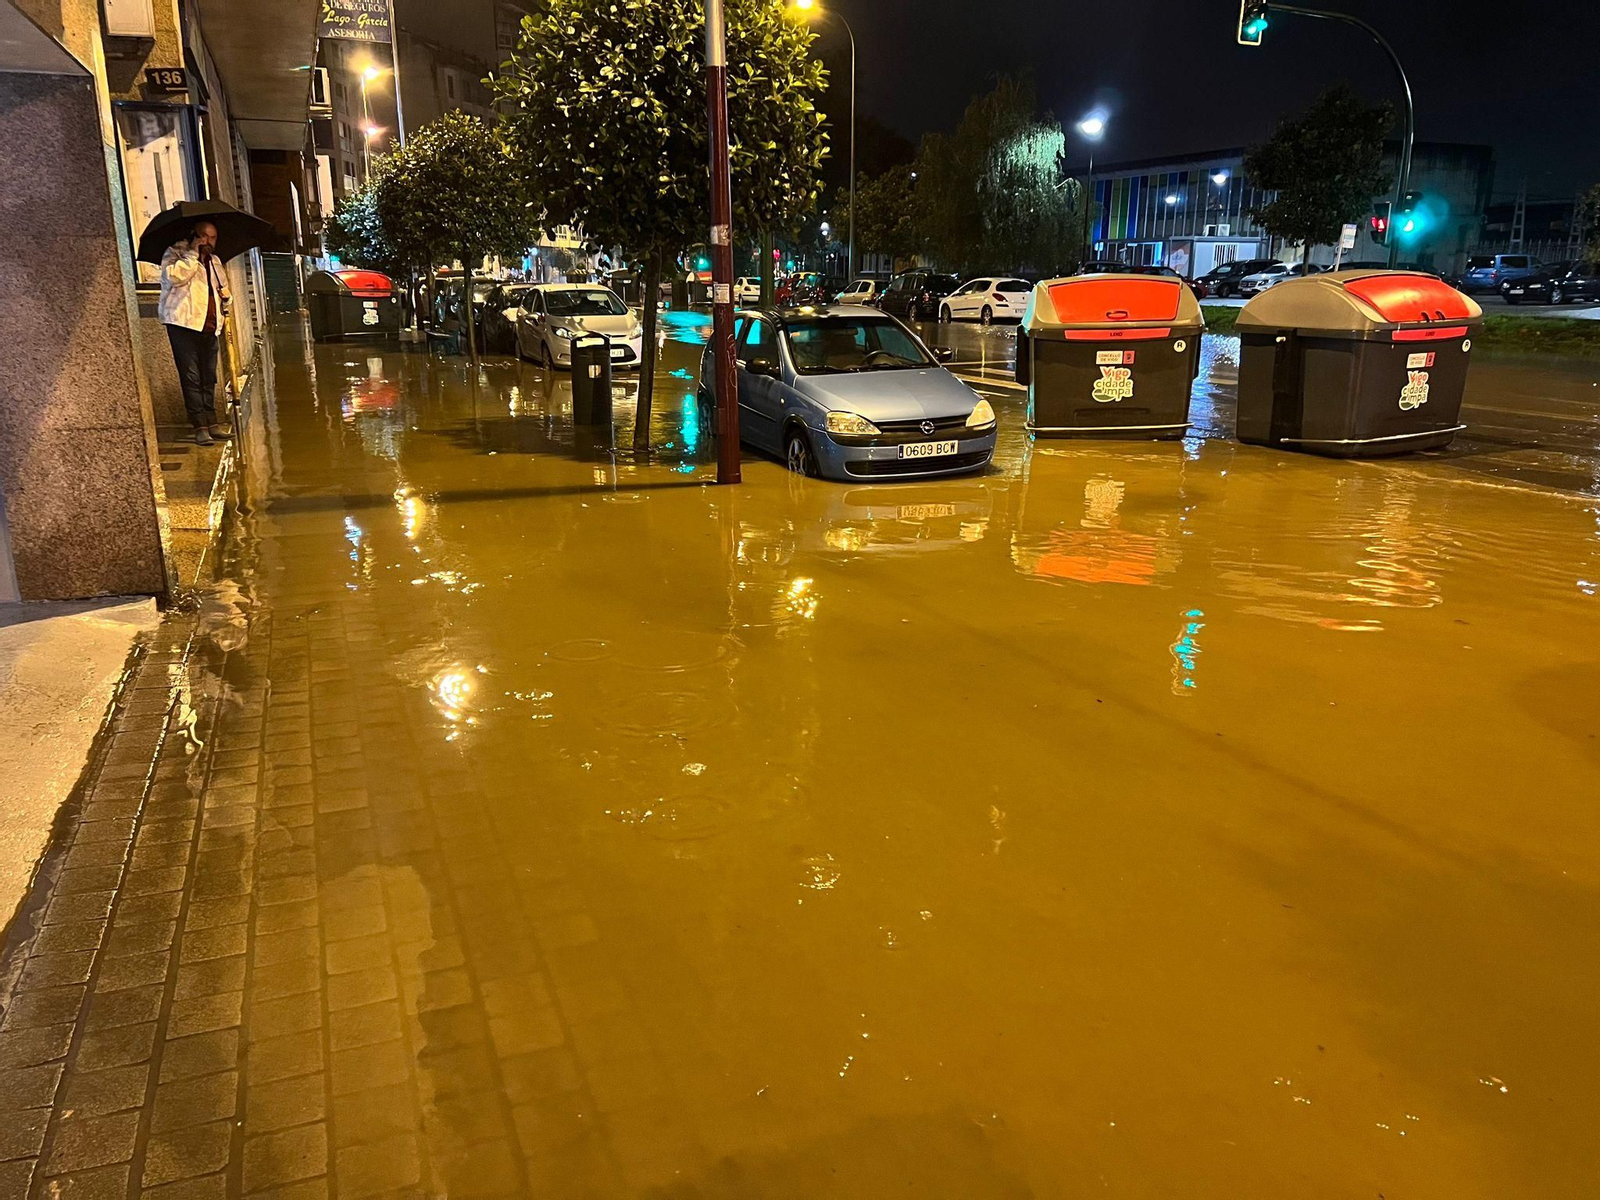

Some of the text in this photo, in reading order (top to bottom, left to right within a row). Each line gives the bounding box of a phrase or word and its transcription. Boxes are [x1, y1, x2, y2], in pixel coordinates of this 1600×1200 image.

[343, 2, 386, 13] SEGUROS
[323, 10, 351, 26] Lago
[328, 28, 376, 40] ASESORIA
[151, 71, 182, 85] 136
[1102, 368, 1129, 381] Vigo
[1095, 377, 1132, 388] cidade
[905, 442, 956, 457] 0609 BCW
